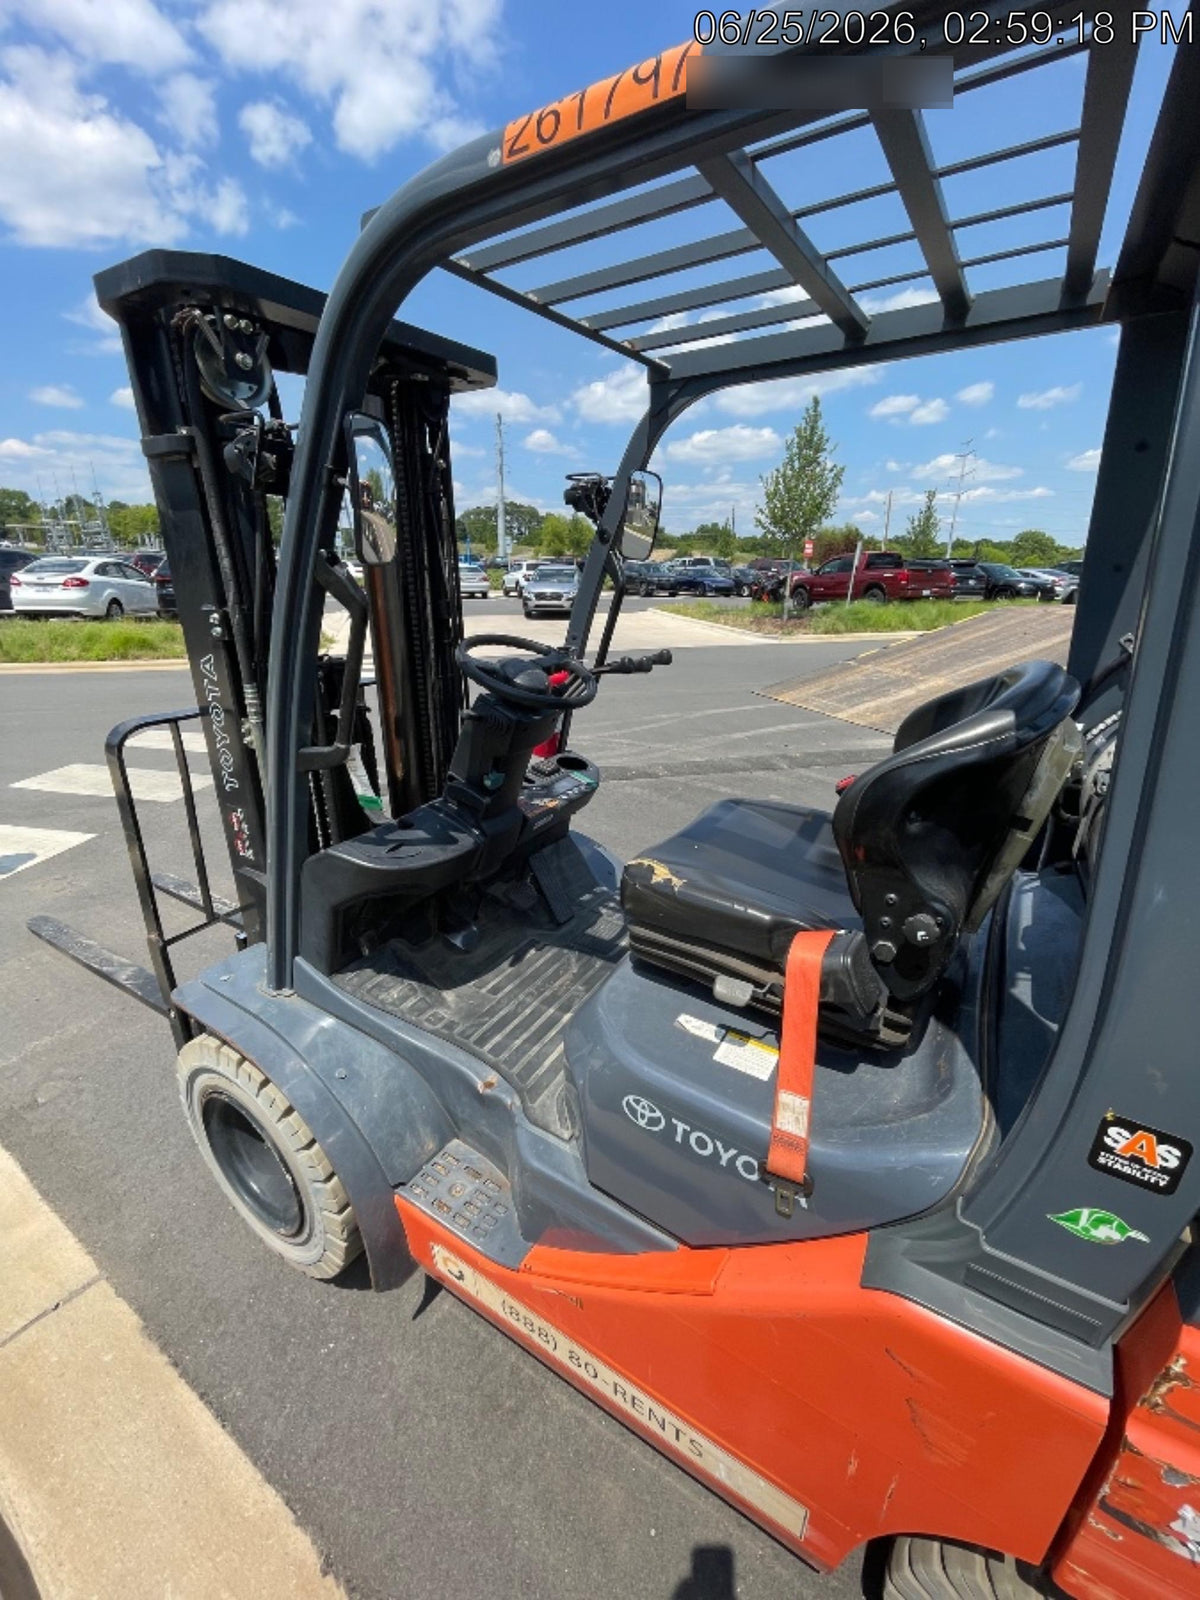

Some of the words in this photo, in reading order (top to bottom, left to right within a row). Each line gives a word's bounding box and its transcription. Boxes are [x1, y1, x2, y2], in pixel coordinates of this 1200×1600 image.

[200, 653, 240, 792] TOYOTA
[1103, 1126, 1182, 1169] SAS
[502, 1299, 557, 1352] (888)
[568, 1349, 703, 1458] 80-RENTS
